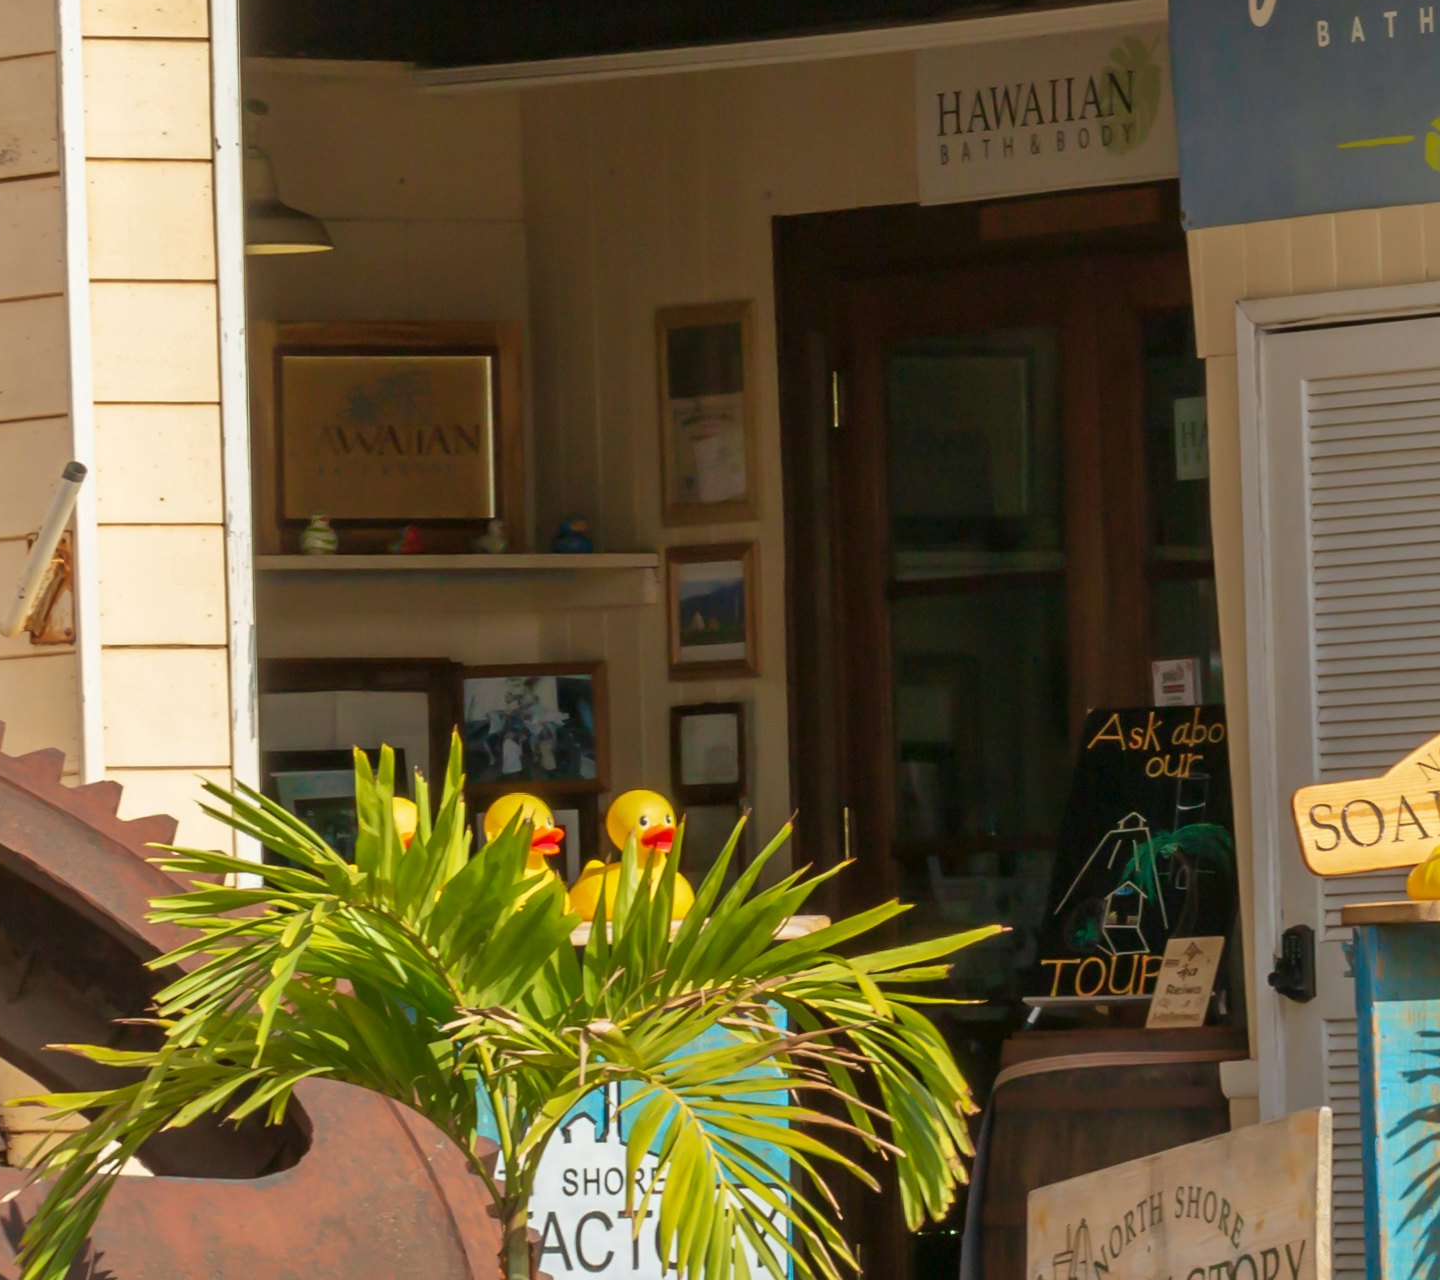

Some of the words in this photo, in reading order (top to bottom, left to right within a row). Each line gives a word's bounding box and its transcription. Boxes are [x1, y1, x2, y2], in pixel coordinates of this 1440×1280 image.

[936, 70, 1136, 137] HAWAIIAN
[1087, 711, 1163, 751] Ask
[1145, 753, 1205, 778] our
[562, 1167, 666, 1197] SHORE
[1175, 1185, 1245, 1249] SHORE
